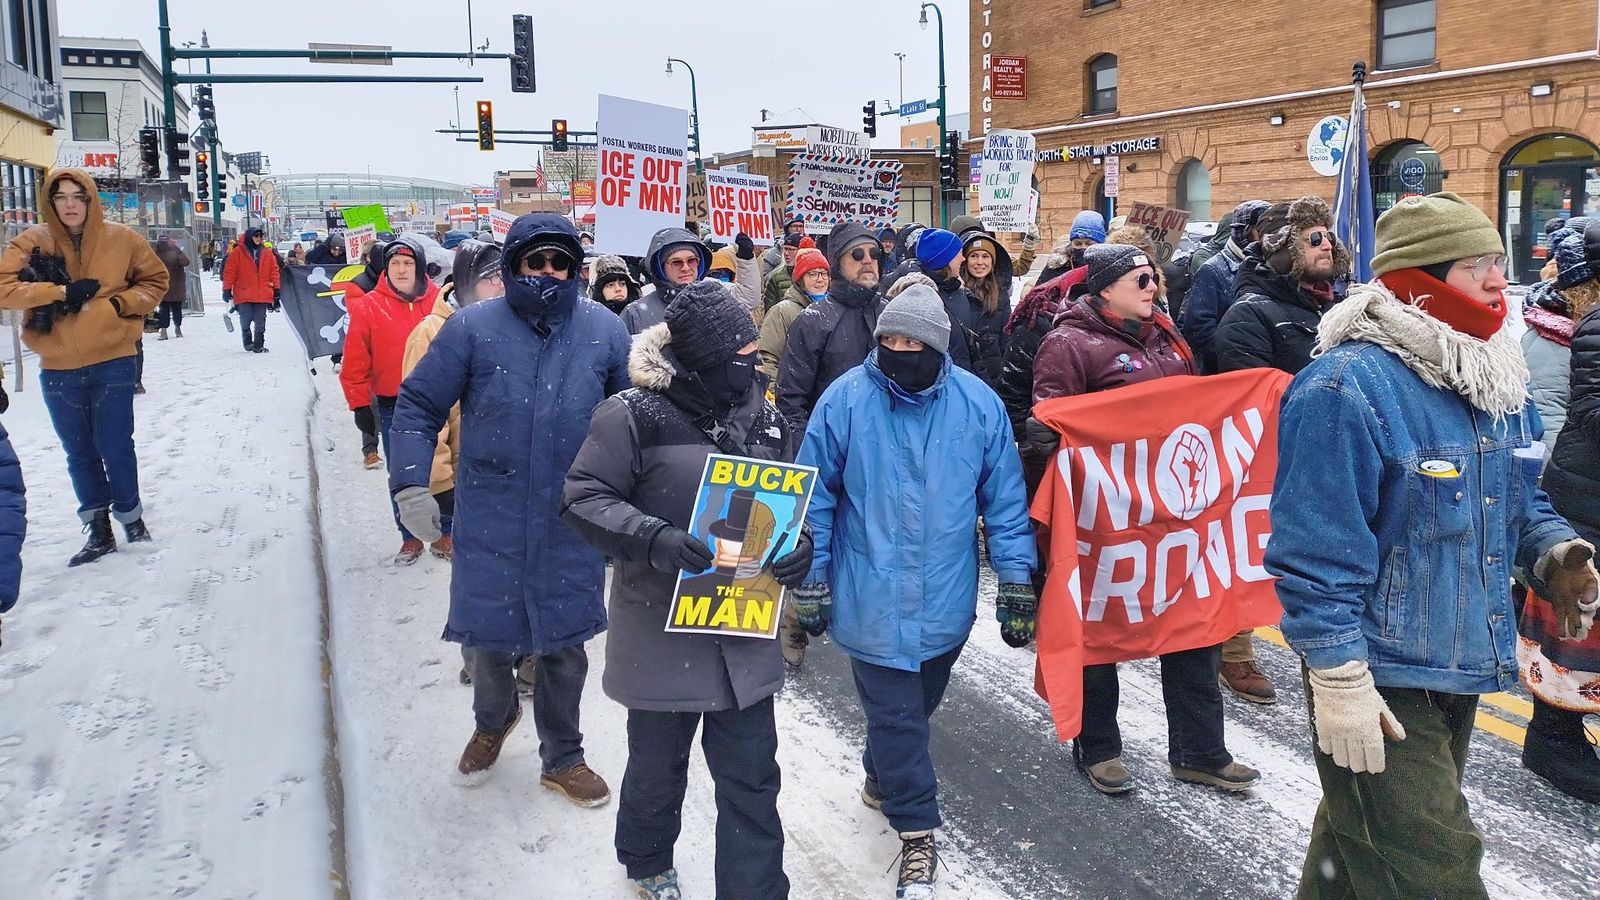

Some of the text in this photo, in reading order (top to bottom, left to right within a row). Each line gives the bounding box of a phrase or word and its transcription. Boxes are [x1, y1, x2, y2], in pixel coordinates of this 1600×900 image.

[982, 0, 992, 134] TORAGE
[993, 66, 1014, 74] REALTY,
[602, 136, 684, 157] POSTAL WORKERS DEMAND
[820, 128, 859, 146] MOBILIZE
[989, 134, 1029, 149] BRING OUT
[807, 143, 870, 162] WORKERS POWER
[984, 148, 1015, 161] WORKERS
[1016, 149, 1034, 162] POWER
[1033, 138, 1157, 162] NORTH STAR MINI STORAGE
[601, 149, 636, 179] ICE
[642, 156, 683, 185] OUT
[708, 174, 768, 188] POSTAL WORKERS DEMAND
[1008, 172, 1020, 185] OUT
[601, 177, 682, 214] OF MN!
[709, 184, 768, 213] ICE OUT
[993, 186, 1014, 200] NOW!
[804, 195, 887, 217] SENDING LOVE
[713, 210, 735, 236] OF
[737, 212, 771, 240] MN!
[1129, 203, 1189, 231] ICE OUT
[349, 236, 359, 247] ICE
[350, 247, 359, 258] OF
[710, 460, 809, 495] BUCK
[1068, 494, 1281, 624] RONG
[716, 586, 745, 597] THE
[674, 596, 774, 631] MAN
